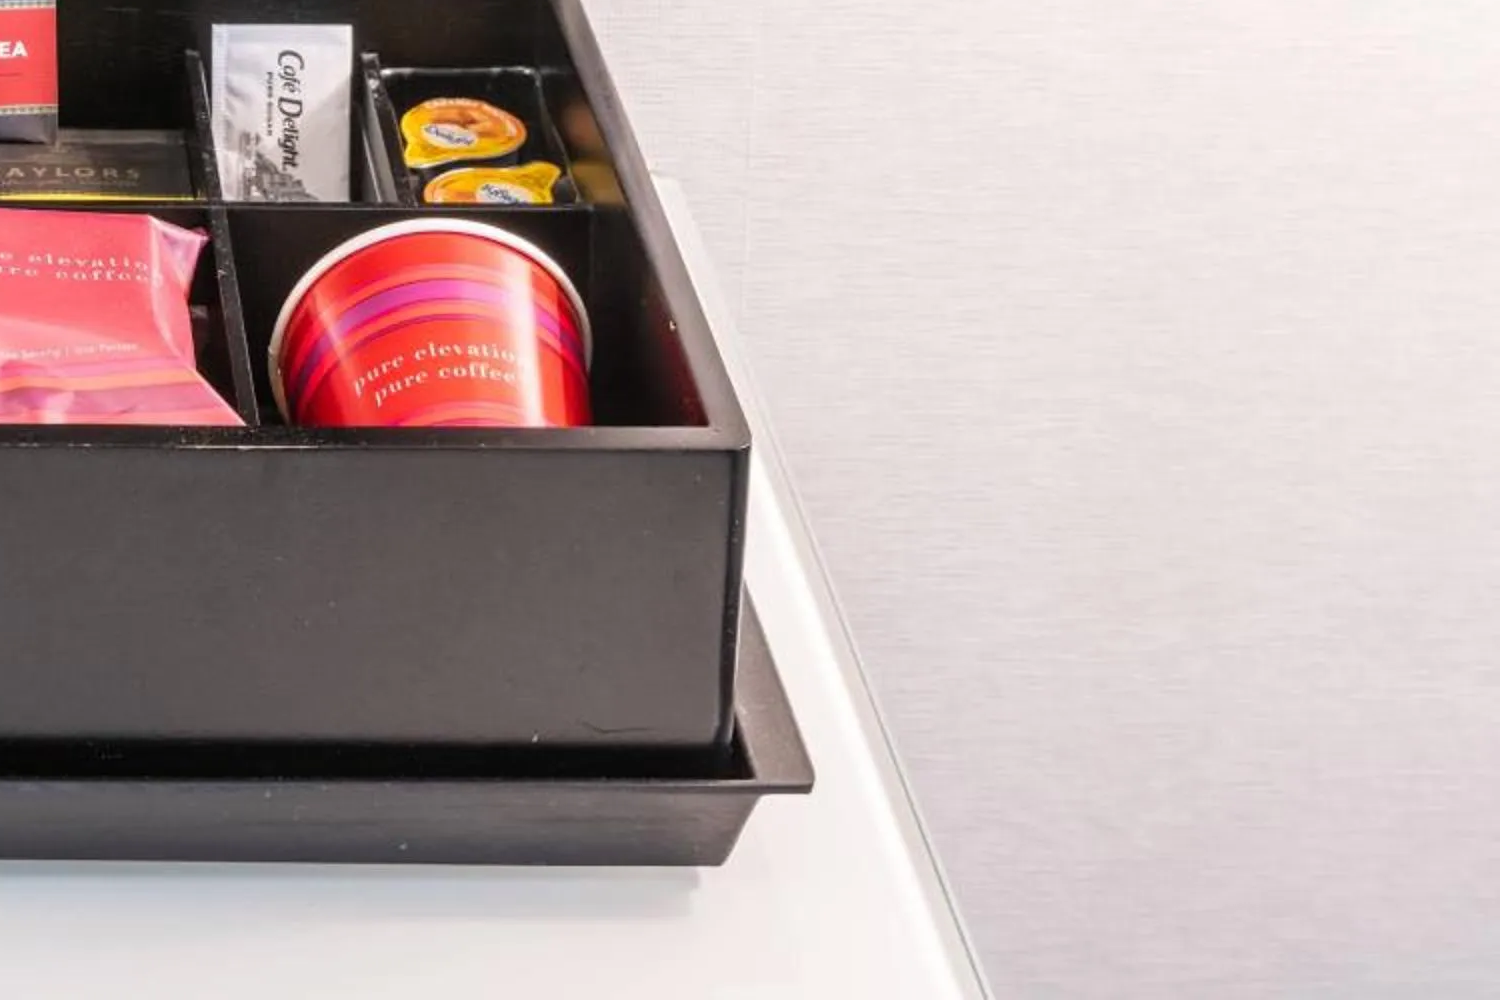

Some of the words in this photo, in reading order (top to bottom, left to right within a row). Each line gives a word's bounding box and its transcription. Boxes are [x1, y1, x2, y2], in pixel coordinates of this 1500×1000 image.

[277, 50, 305, 93] Café
[27, 252, 150, 272] elevatio
[352, 354, 405, 398] pure
[414, 340, 518, 365] elevatio
[373, 369, 430, 409] pure
